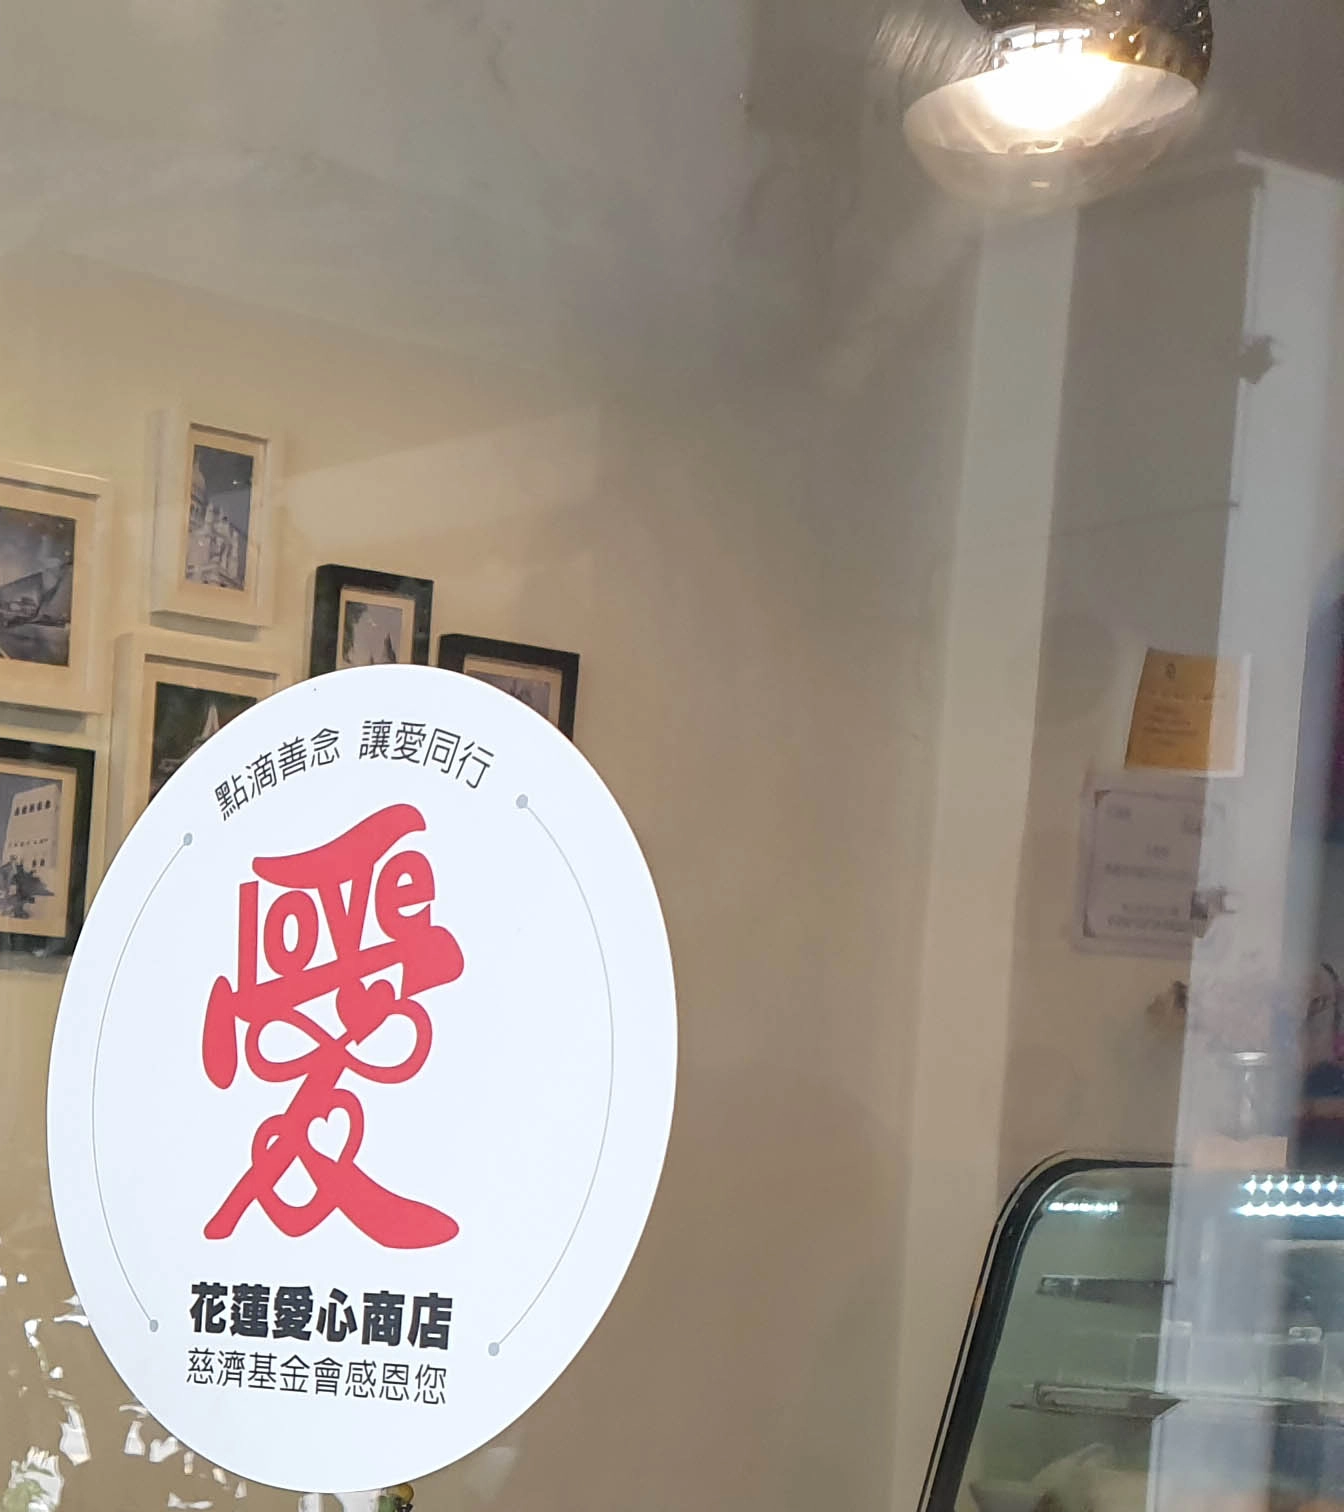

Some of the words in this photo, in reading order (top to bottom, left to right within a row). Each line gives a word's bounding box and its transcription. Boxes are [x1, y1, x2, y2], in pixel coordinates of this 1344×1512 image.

[214, 726, 342, 821] 點滴善念
[359, 717, 495, 789] 讓愛同行
[189, 1280, 453, 1350] 花蓮愛心商店
[185, 1347, 448, 1406] 慈濟基金會感恩您
